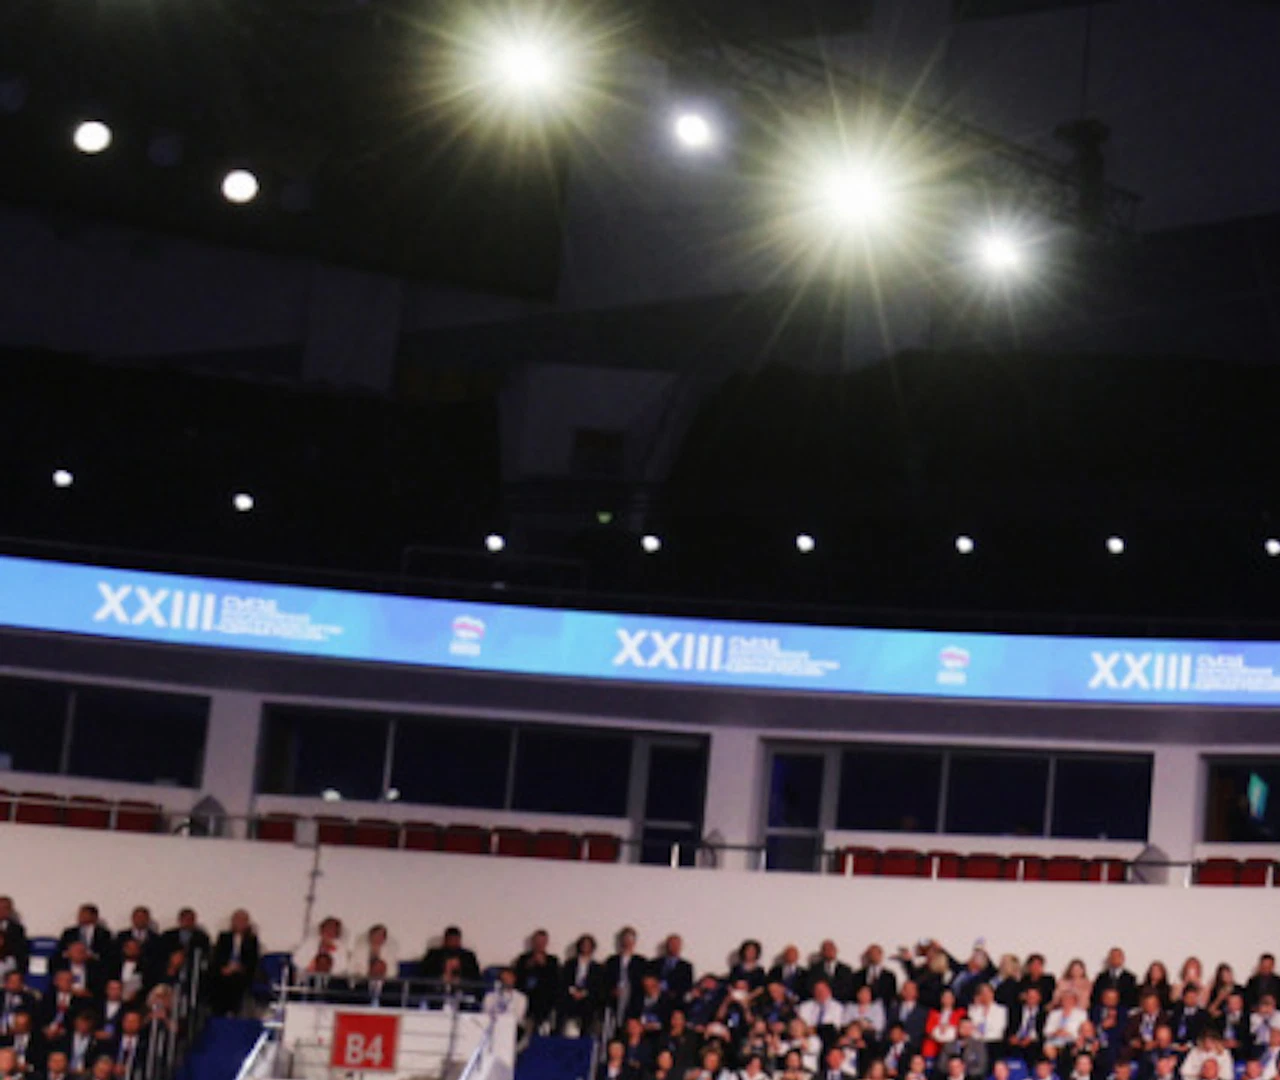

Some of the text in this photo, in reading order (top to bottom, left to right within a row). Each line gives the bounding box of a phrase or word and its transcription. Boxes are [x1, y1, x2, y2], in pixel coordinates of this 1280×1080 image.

[94, 582, 216, 632] XXIII
[612, 628, 725, 673] XXIII
[1087, 651, 1193, 691] XXIII
[344, 1032, 384, 1065] B4
